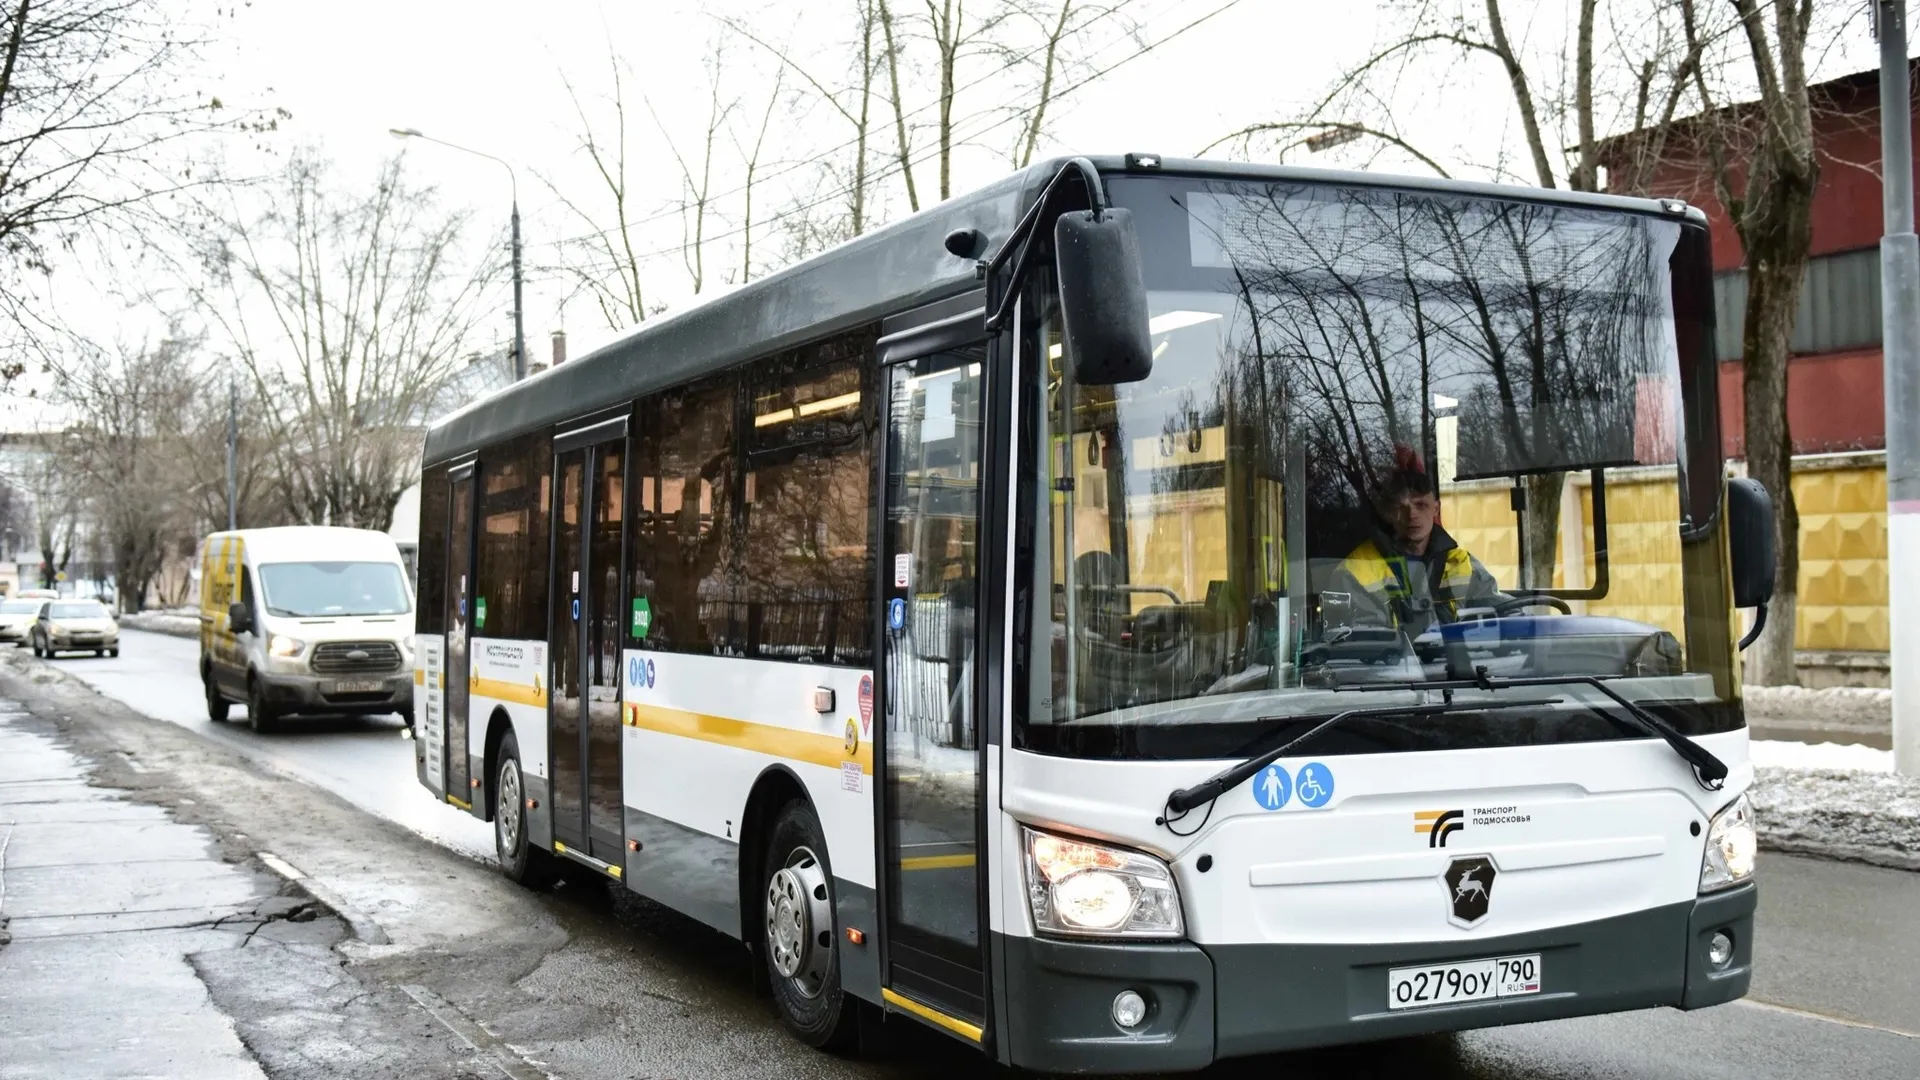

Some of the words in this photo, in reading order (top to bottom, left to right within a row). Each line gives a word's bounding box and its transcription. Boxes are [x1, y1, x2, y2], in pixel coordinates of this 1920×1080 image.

[1473, 806, 1517, 815] ТРАНСПОРТ
[1473, 815, 1531, 825] ПОДМОСКОВЬЯ
[1498, 959, 1534, 983] 790
[1507, 983, 1524, 992] RUS
